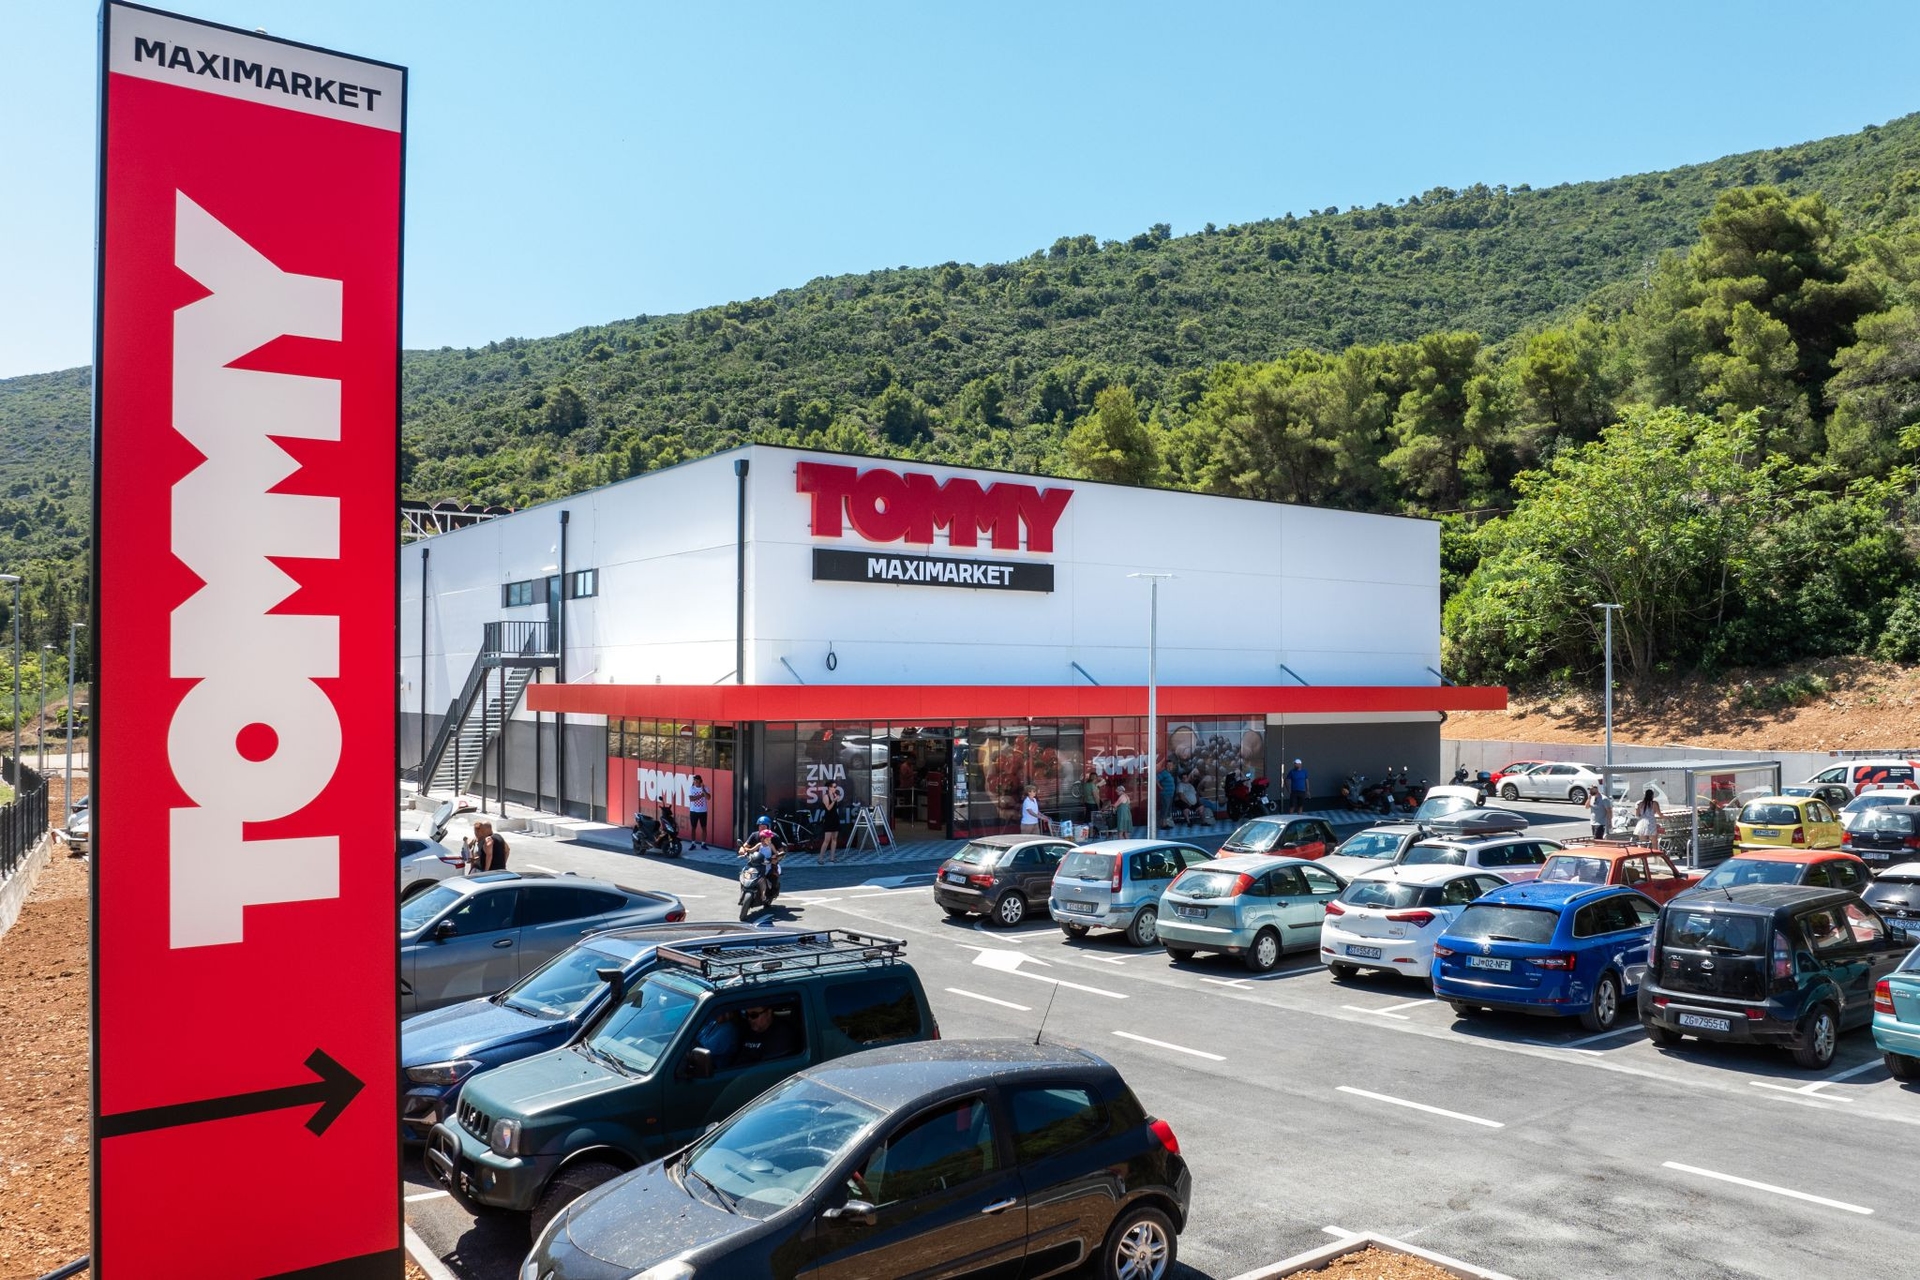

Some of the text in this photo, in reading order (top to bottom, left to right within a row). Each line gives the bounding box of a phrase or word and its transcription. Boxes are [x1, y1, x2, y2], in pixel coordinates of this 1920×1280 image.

[134, 36, 382, 112] MAXIMARKET
[796, 461, 1075, 553] TOMMY
[167, 188, 343, 949] TOMMY
[867, 557, 1014, 586] MAXIMARKET
[806, 763, 847, 781] ZNA
[1699, 1016, 1730, 1031] 7955-EN
